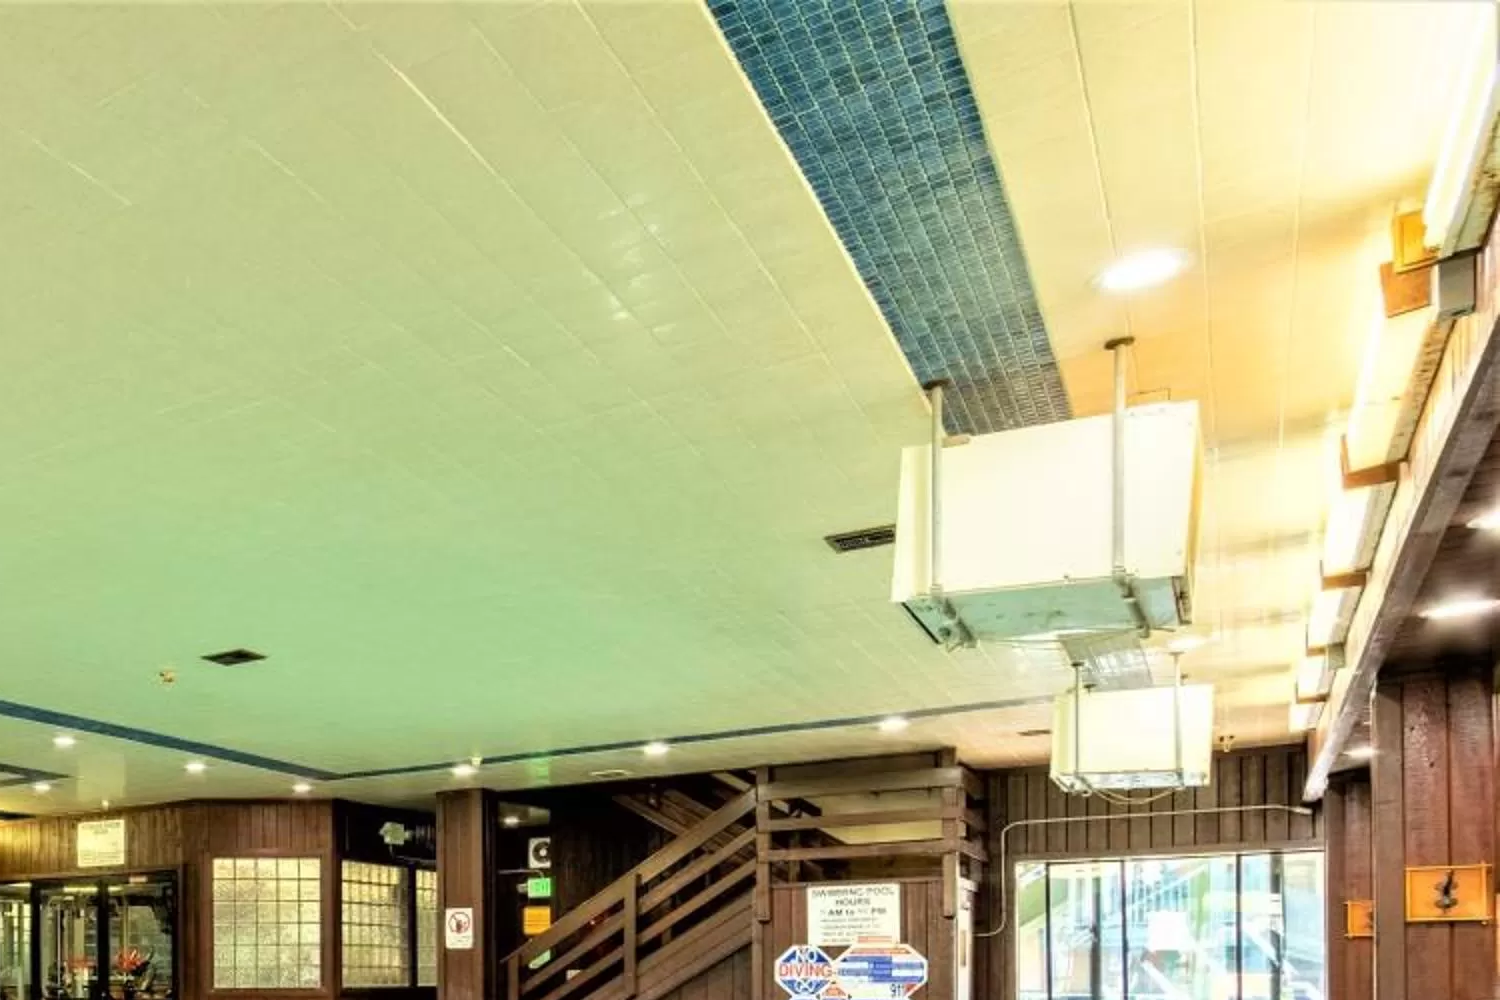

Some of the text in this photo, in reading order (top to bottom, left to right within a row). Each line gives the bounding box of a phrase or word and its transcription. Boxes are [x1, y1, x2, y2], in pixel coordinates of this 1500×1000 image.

[828, 908, 843, 916] AM
[795, 947, 818, 963] NO
[779, 963, 833, 978] DIVING
